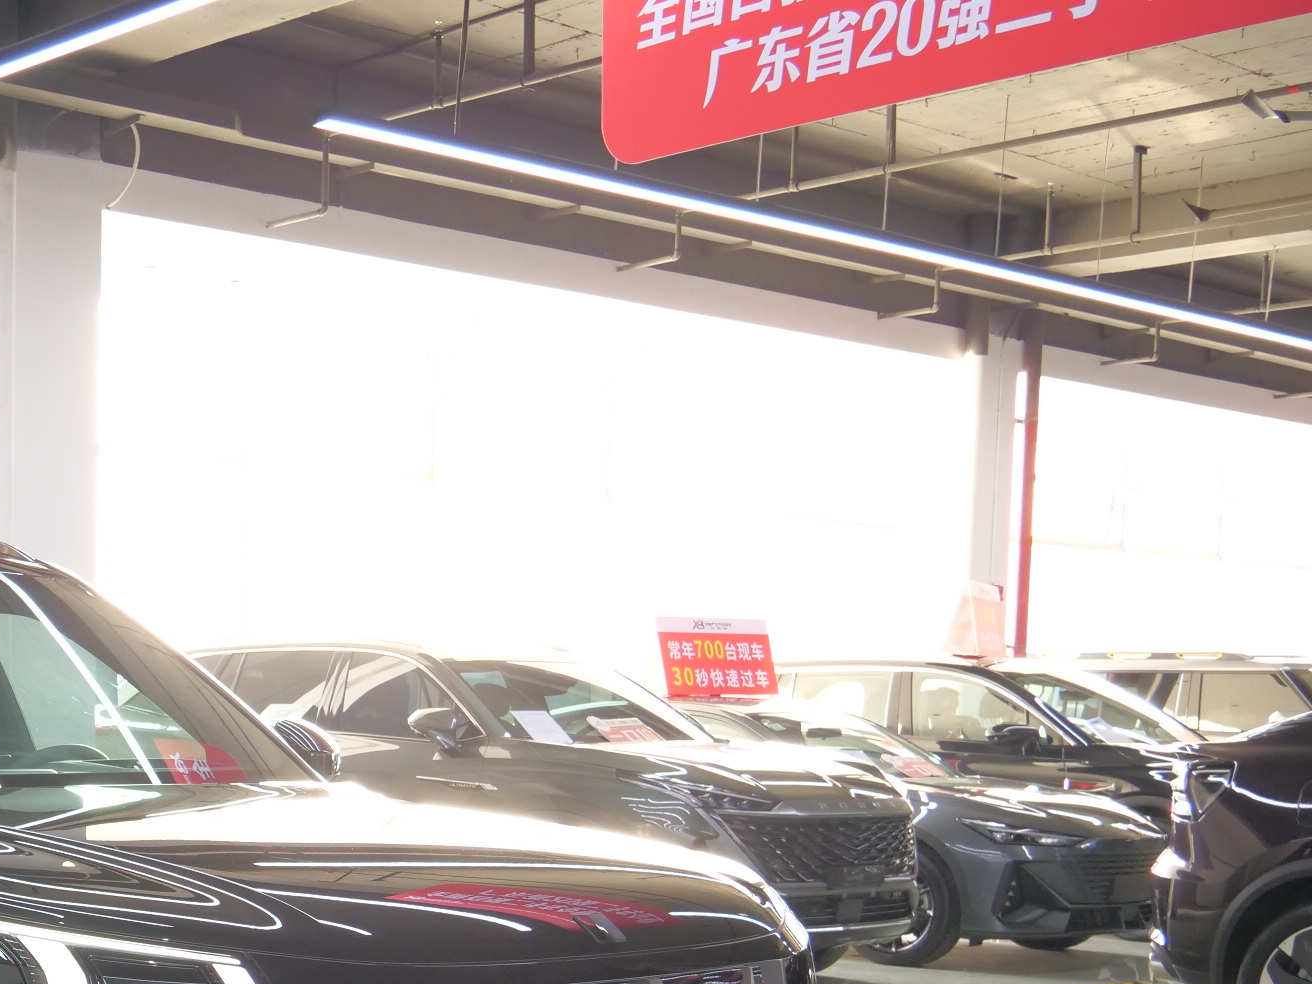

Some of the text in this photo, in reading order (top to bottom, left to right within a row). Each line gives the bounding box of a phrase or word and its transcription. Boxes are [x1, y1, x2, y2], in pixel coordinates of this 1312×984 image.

[667, 640, 765, 661] 常年700台现车
[672, 666, 770, 688] 30秒快速过车
